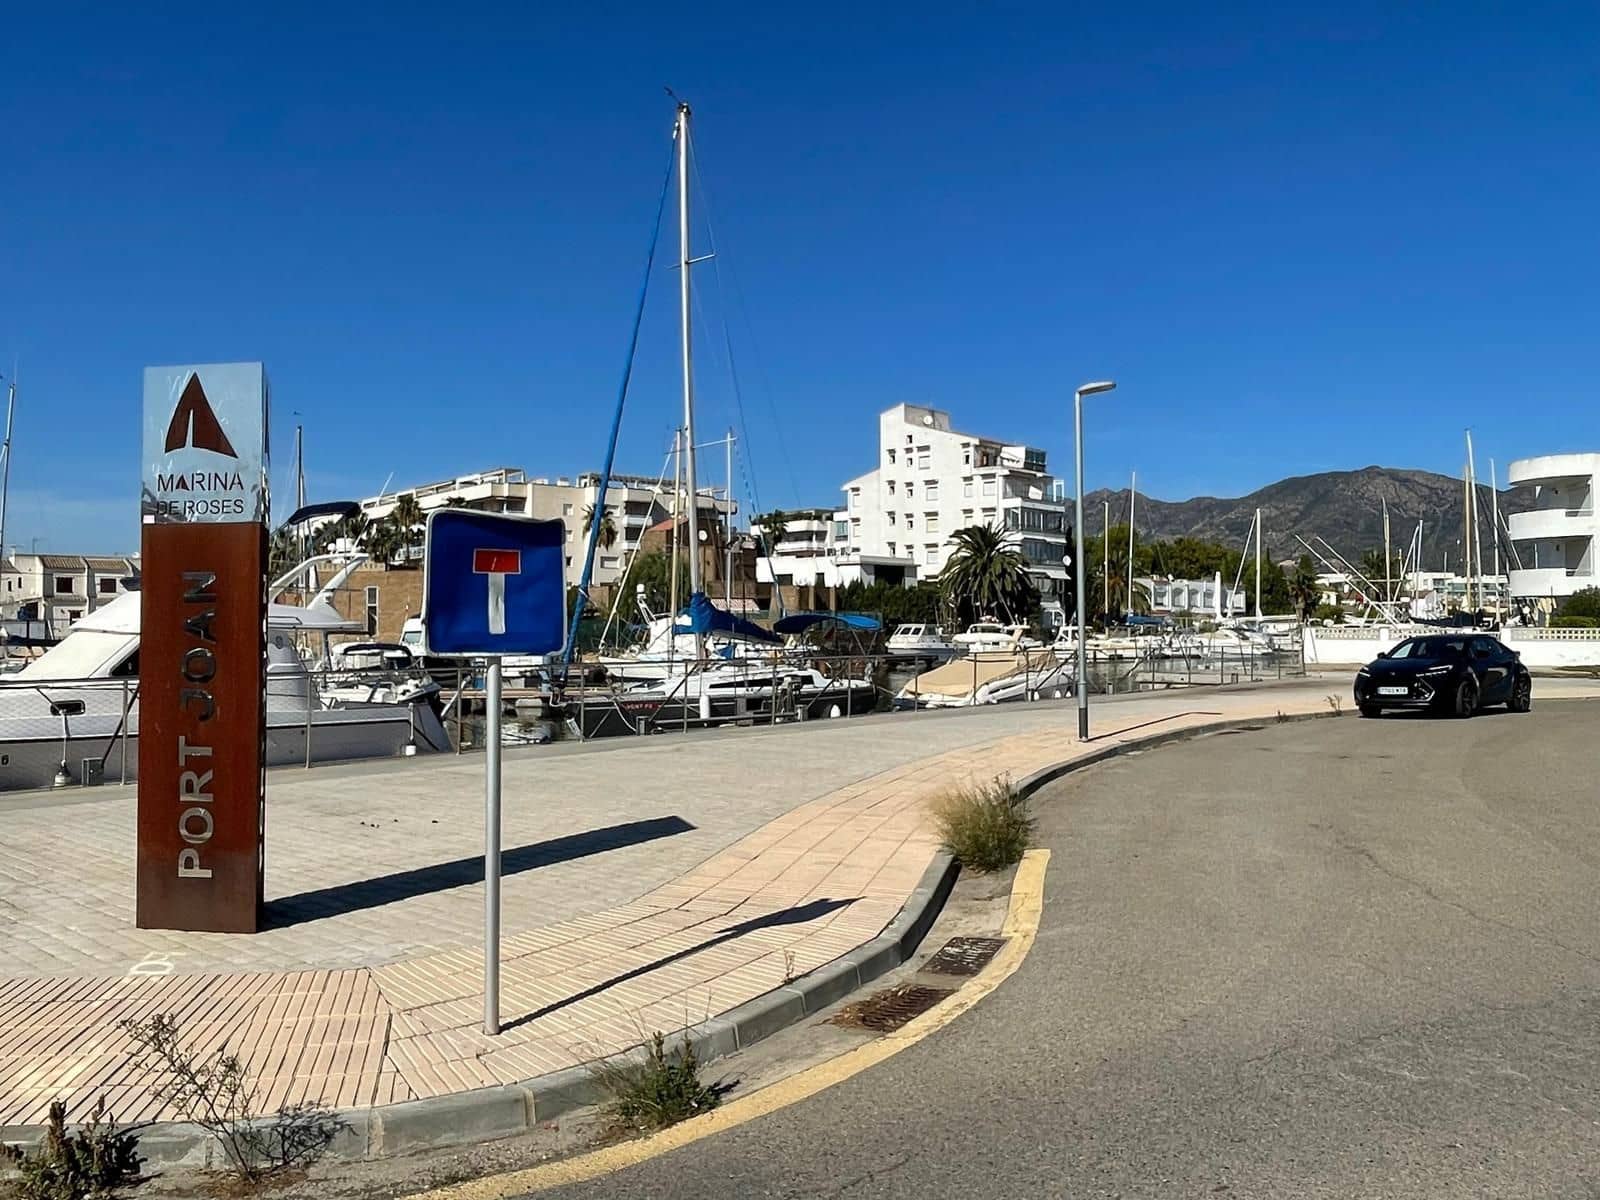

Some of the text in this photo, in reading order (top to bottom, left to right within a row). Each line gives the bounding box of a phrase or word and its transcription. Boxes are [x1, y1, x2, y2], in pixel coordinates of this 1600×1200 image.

[157, 472, 244, 492] MARINA
[157, 499, 244, 516] DE ROSES
[178, 571, 217, 879] PORT JOAN
